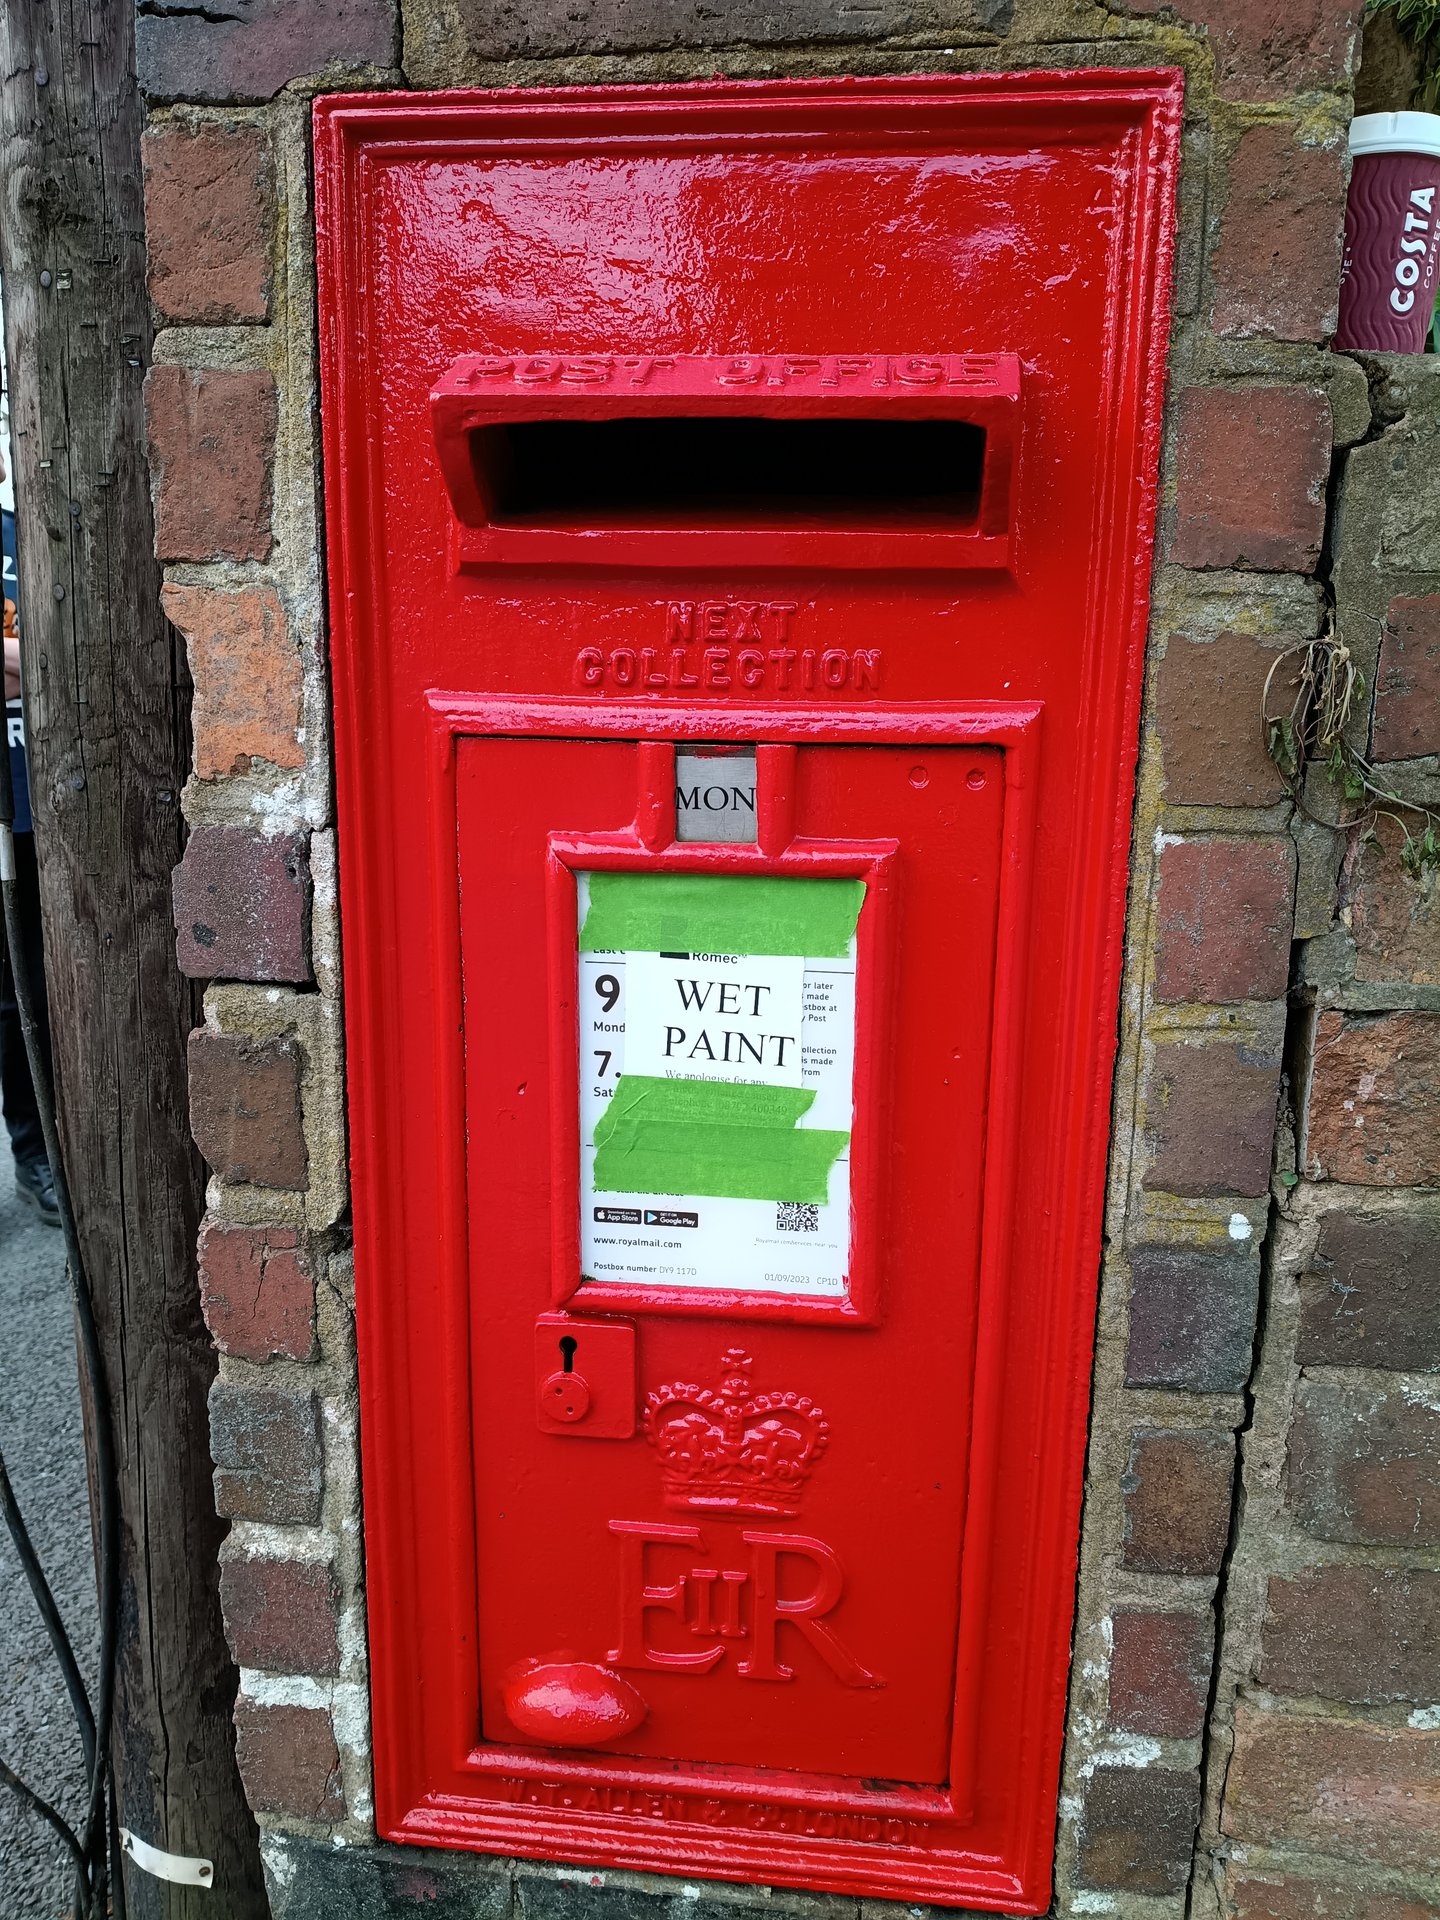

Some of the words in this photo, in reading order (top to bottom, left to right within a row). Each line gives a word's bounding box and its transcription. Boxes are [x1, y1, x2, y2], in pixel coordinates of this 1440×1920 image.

[1390, 187, 1435, 312] COSTA
[454, 357, 676, 386] POST
[716, 357, 1000, 387] OFFICE
[667, 600, 799, 642] NEXT
[575, 646, 882, 691] COLLECTION
[676, 786, 757, 812] MON
[595, 974, 620, 1013] 9
[674, 978, 771, 1016] WET
[808, 1014, 826, 1022] Post
[662, 1025, 795, 1068] PAINT
[665, 1069, 677, 1080] We
[734, 1076, 747, 1085] for
[607, 1214, 620, 1222] App
[621, 1214, 639, 1222] Store
[660, 1217, 682, 1225] Google
[682, 1218, 695, 1226] Play
[593, 1237, 682, 1249] www.royalmail.com
[593, 1262, 624, 1271] Postbox
[626, 1264, 657, 1273] number
[659, 1266, 674, 1274] DY9
[764, 1272, 810, 1284] 01/09/2023
[796, 1810, 930, 1848] LONDON
